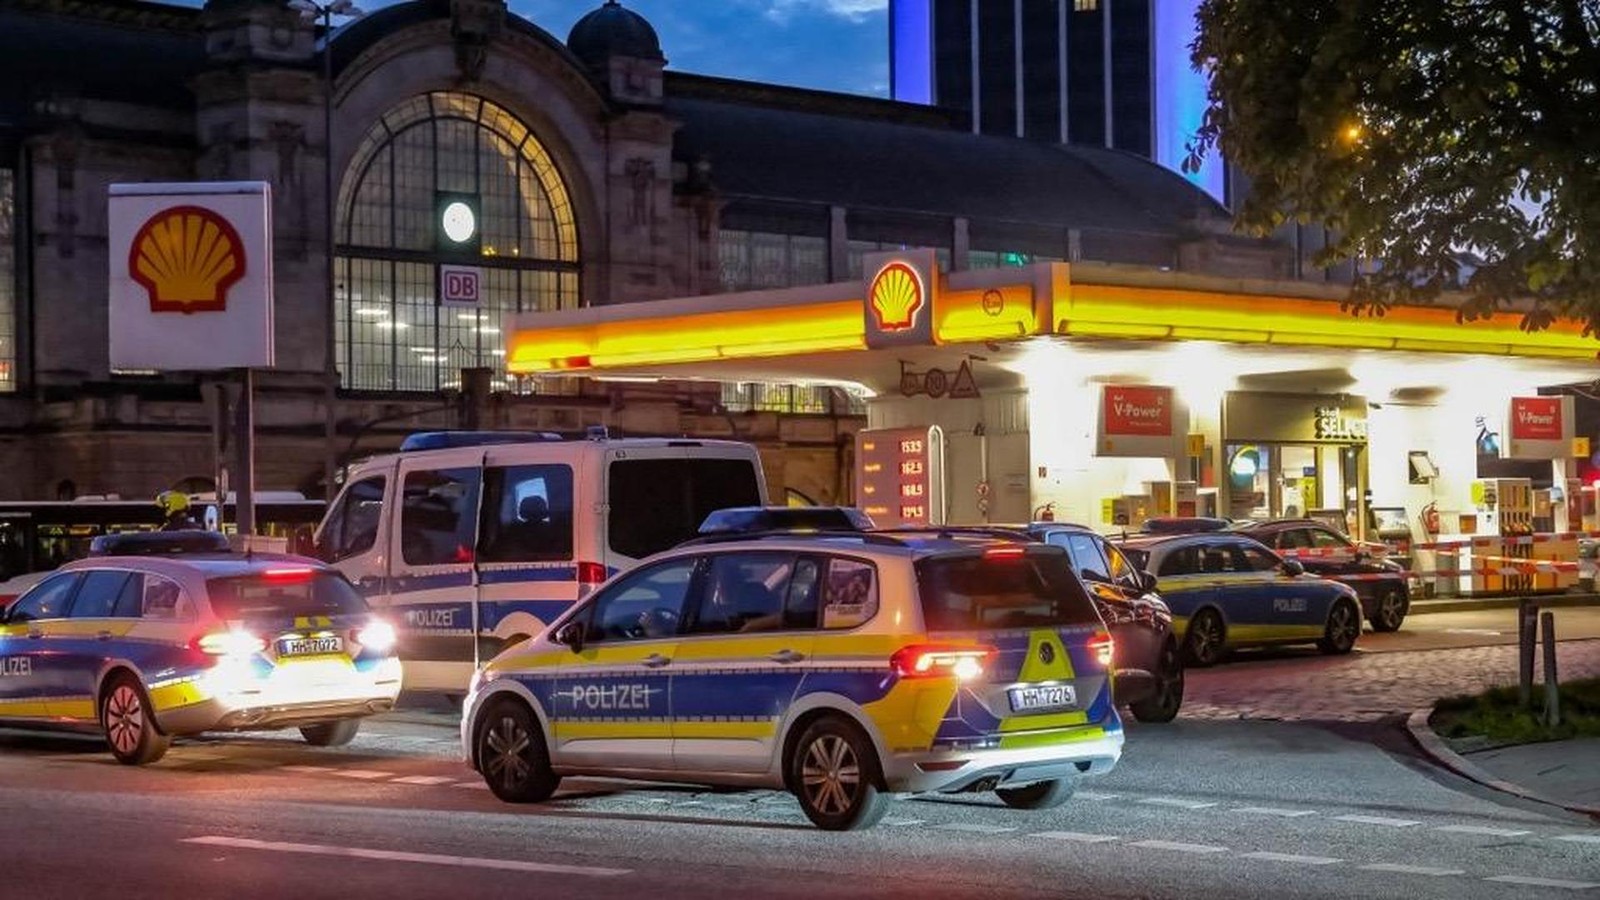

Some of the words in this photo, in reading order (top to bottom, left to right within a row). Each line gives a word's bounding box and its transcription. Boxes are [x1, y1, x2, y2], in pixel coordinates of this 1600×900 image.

[449, 275, 474, 296] DB
[1320, 417, 1367, 436] SEL
[407, 607, 453, 627] POLIZEI
[0, 656, 32, 676] LIZEI
[572, 684, 650, 710] POLIZEI
[1022, 689, 1039, 706] HH
[1046, 687, 1072, 704] 7276
